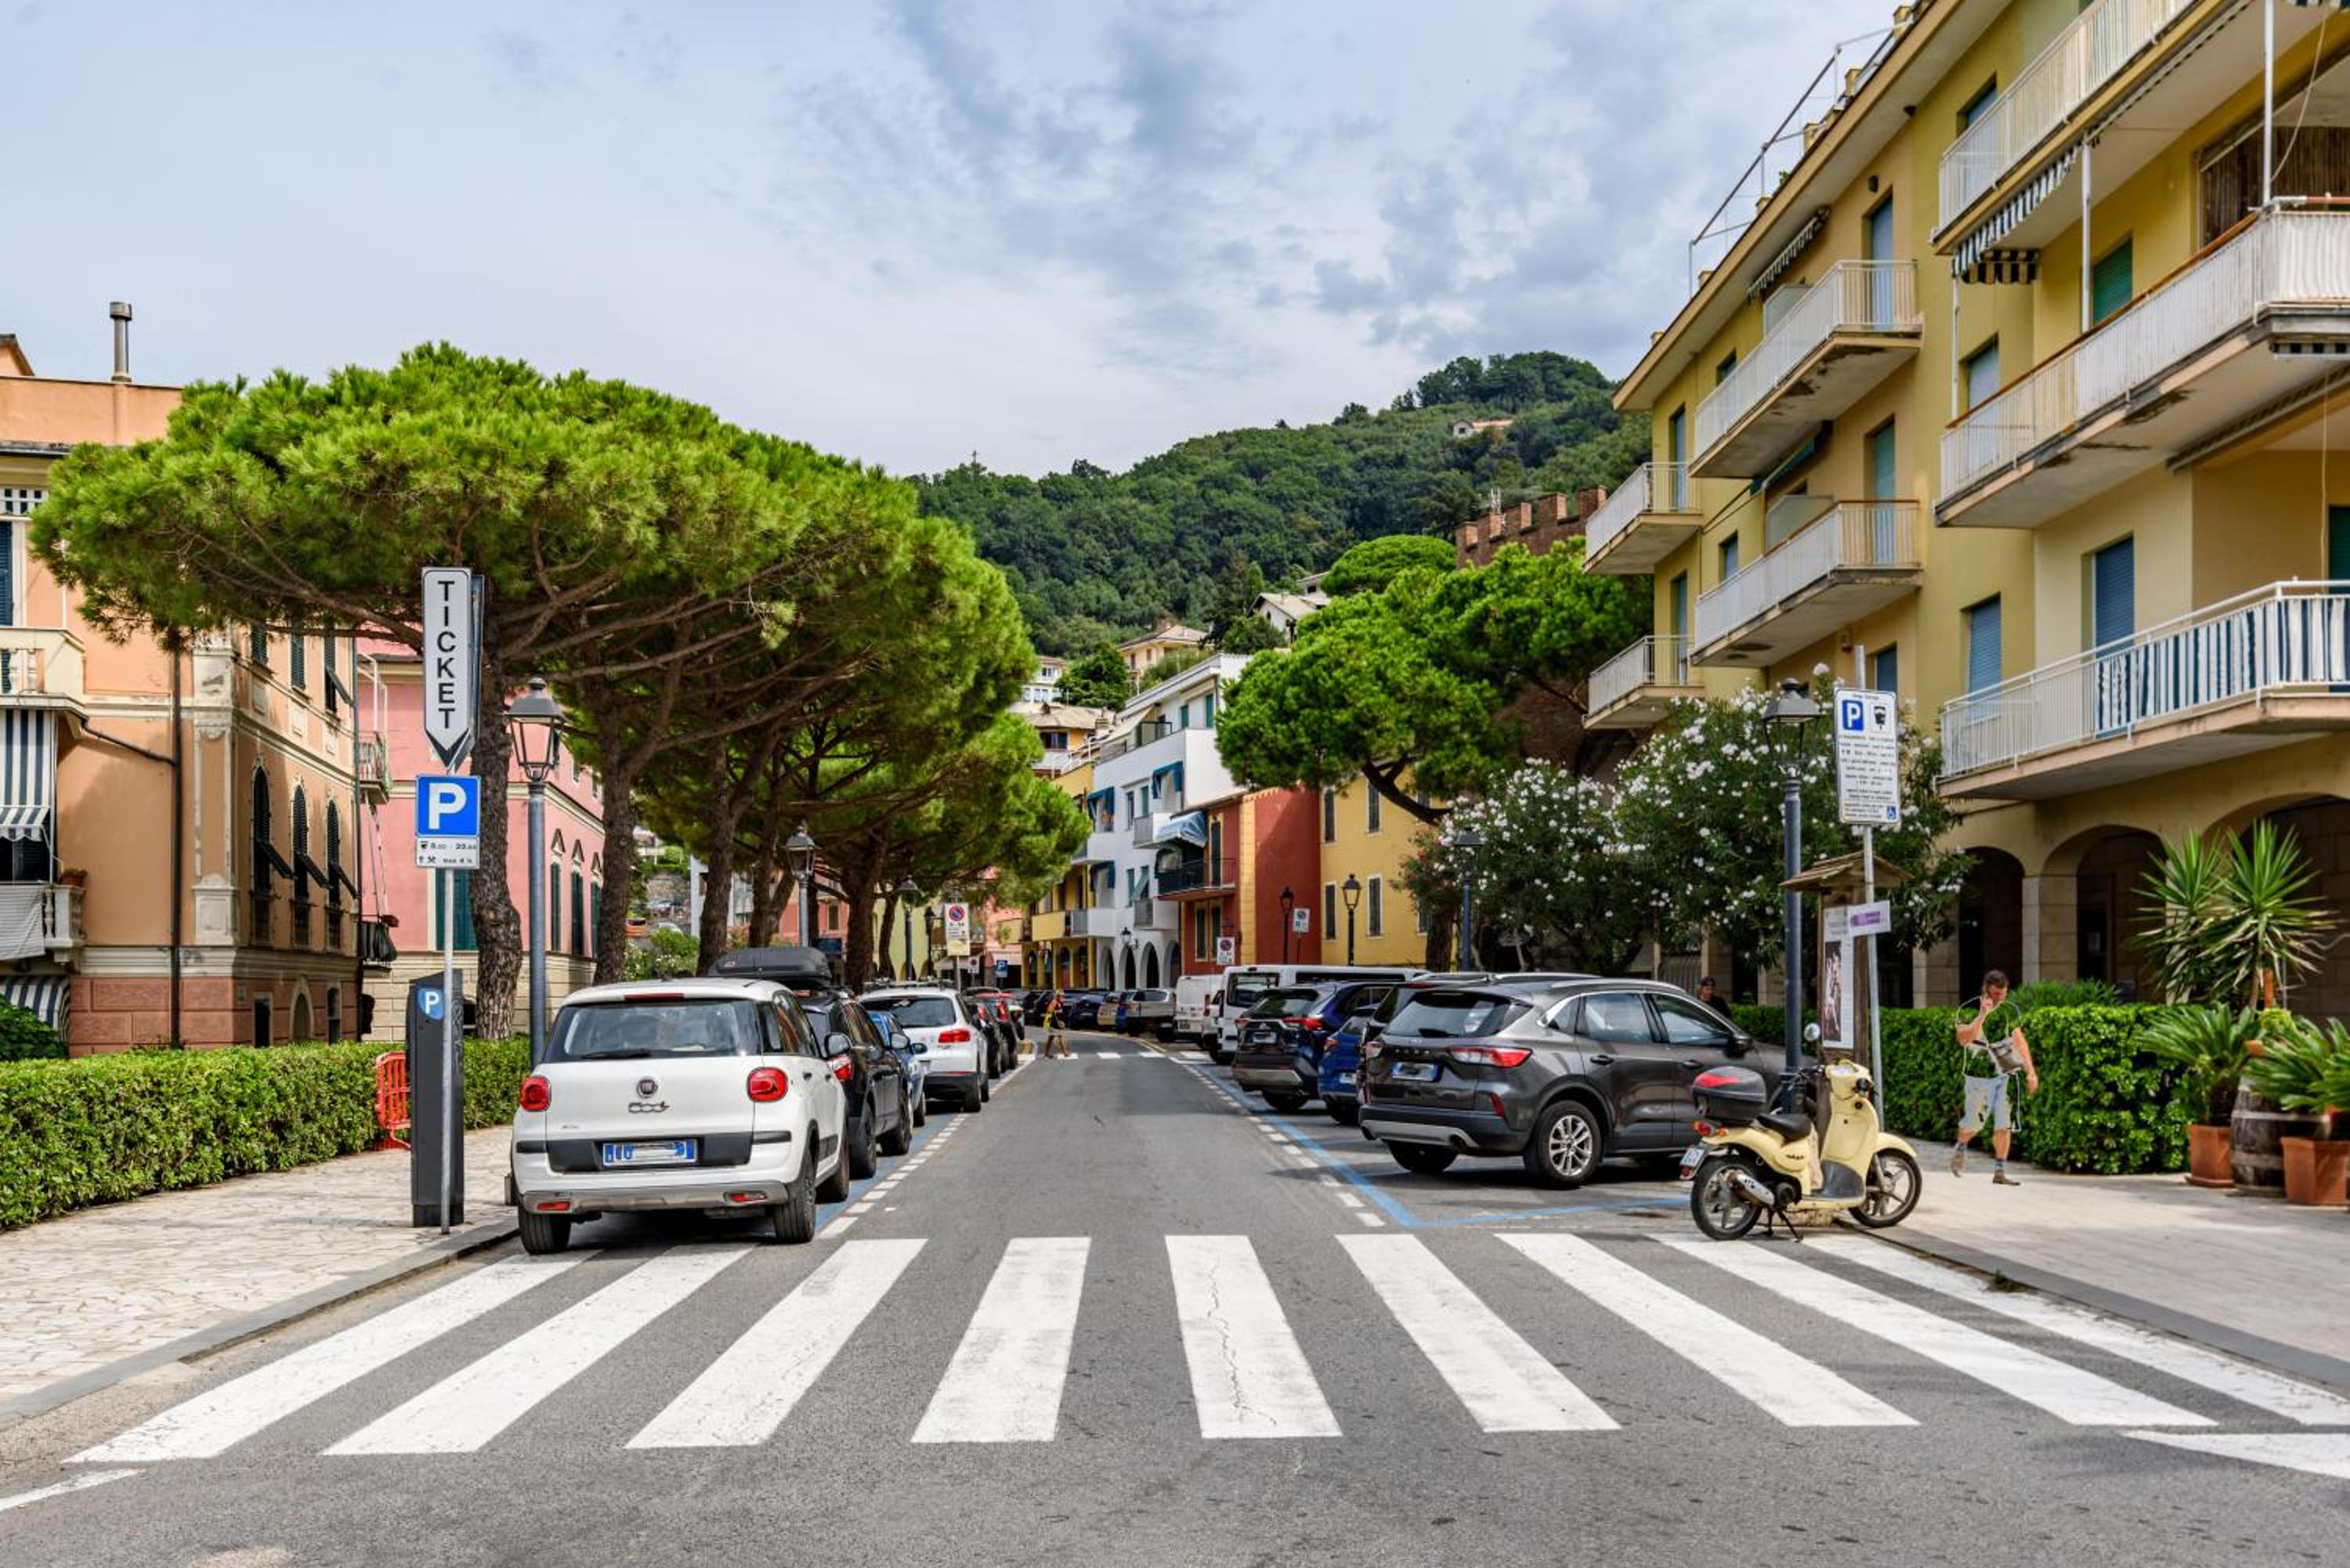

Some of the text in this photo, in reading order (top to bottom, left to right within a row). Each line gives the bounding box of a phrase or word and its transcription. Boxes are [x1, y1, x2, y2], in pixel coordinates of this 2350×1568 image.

[436, 580, 457, 729] TICKET
[1846, 703, 1861, 728] P
[428, 782, 467, 830] P
[425, 991, 439, 1015] P
